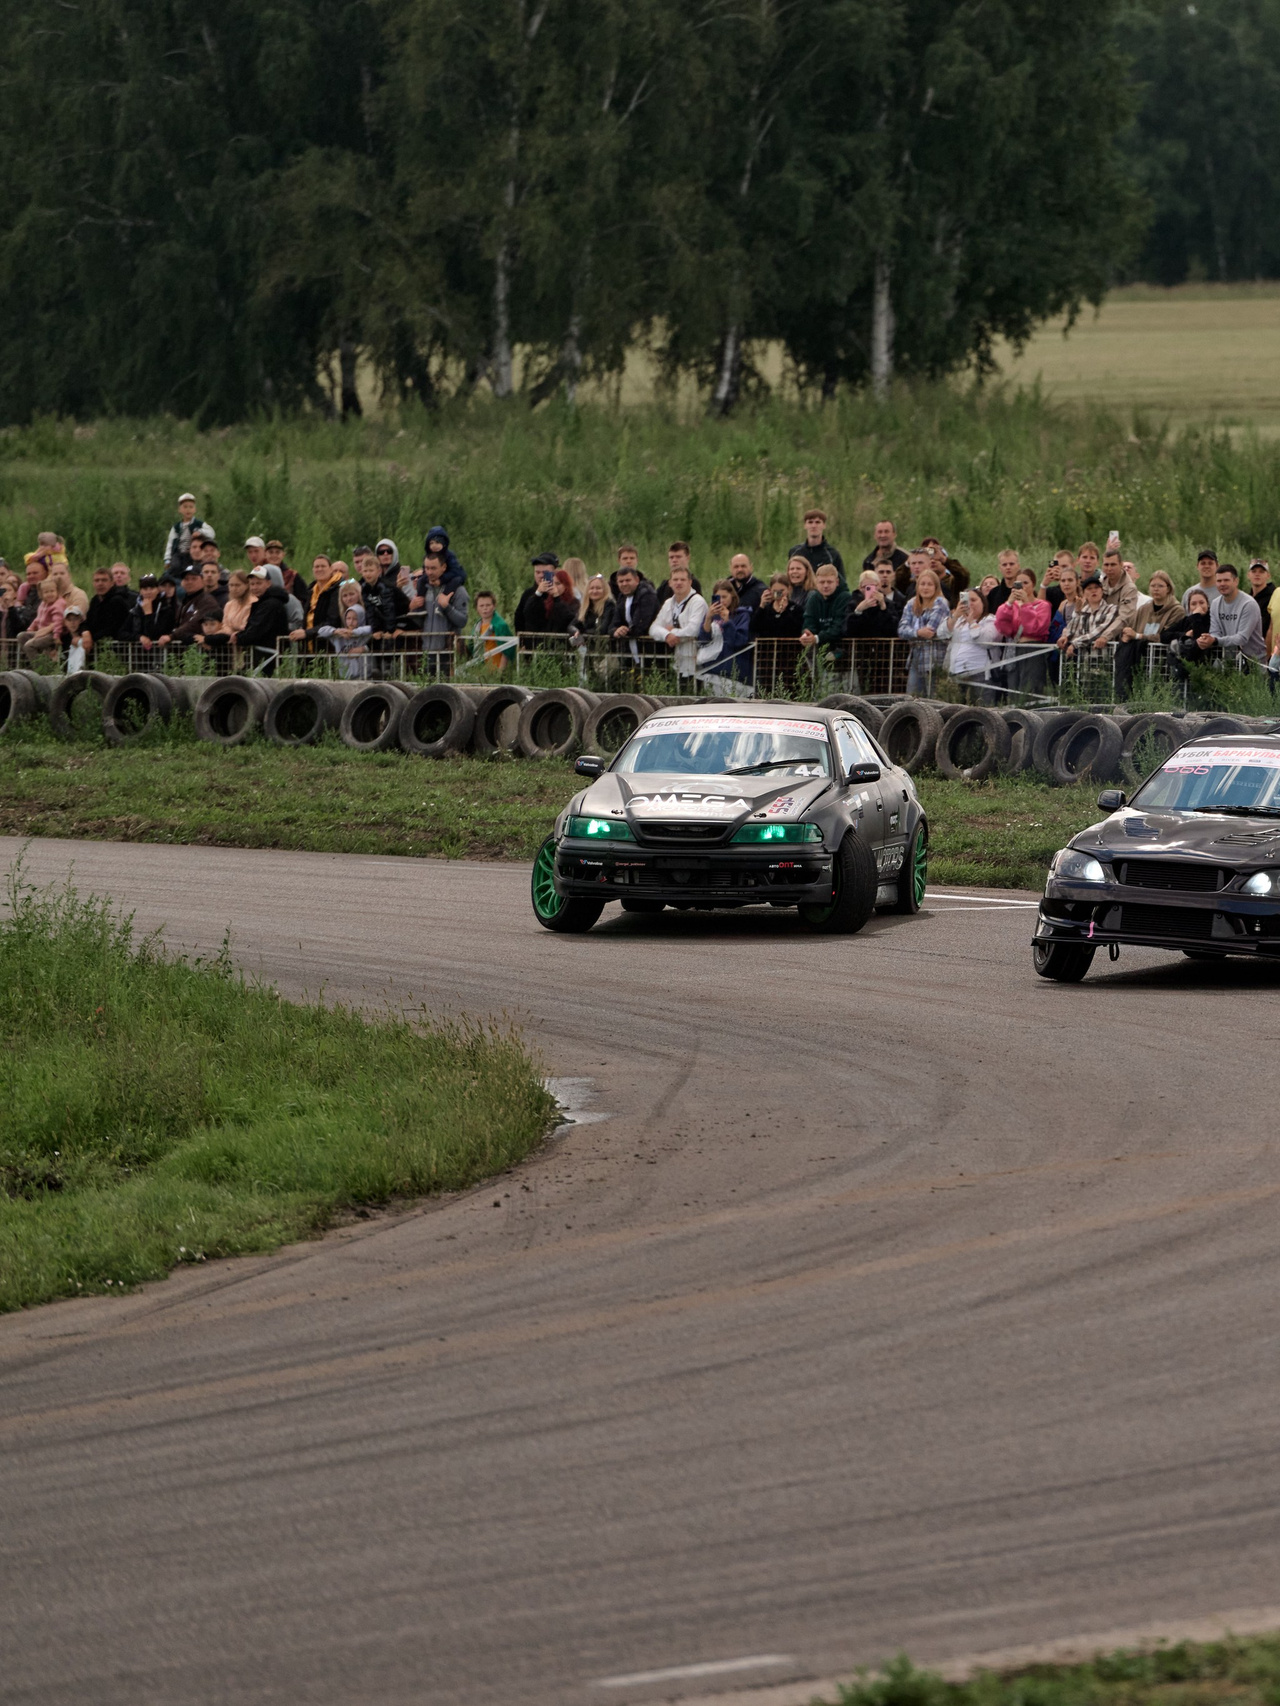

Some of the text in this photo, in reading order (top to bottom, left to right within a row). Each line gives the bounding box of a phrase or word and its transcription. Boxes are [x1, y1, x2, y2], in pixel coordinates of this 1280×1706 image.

[643, 719, 680, 729] КУБОК
[682, 718, 776, 726] БАРНАУЛЬСКОЙ
[776, 721, 825, 732] РАКЕТЫ
[804, 730, 825, 738] 2025
[1174, 750, 1213, 759] КУБОК
[795, 764, 827, 777] 44
[625, 793, 752, 811] OMEGA
